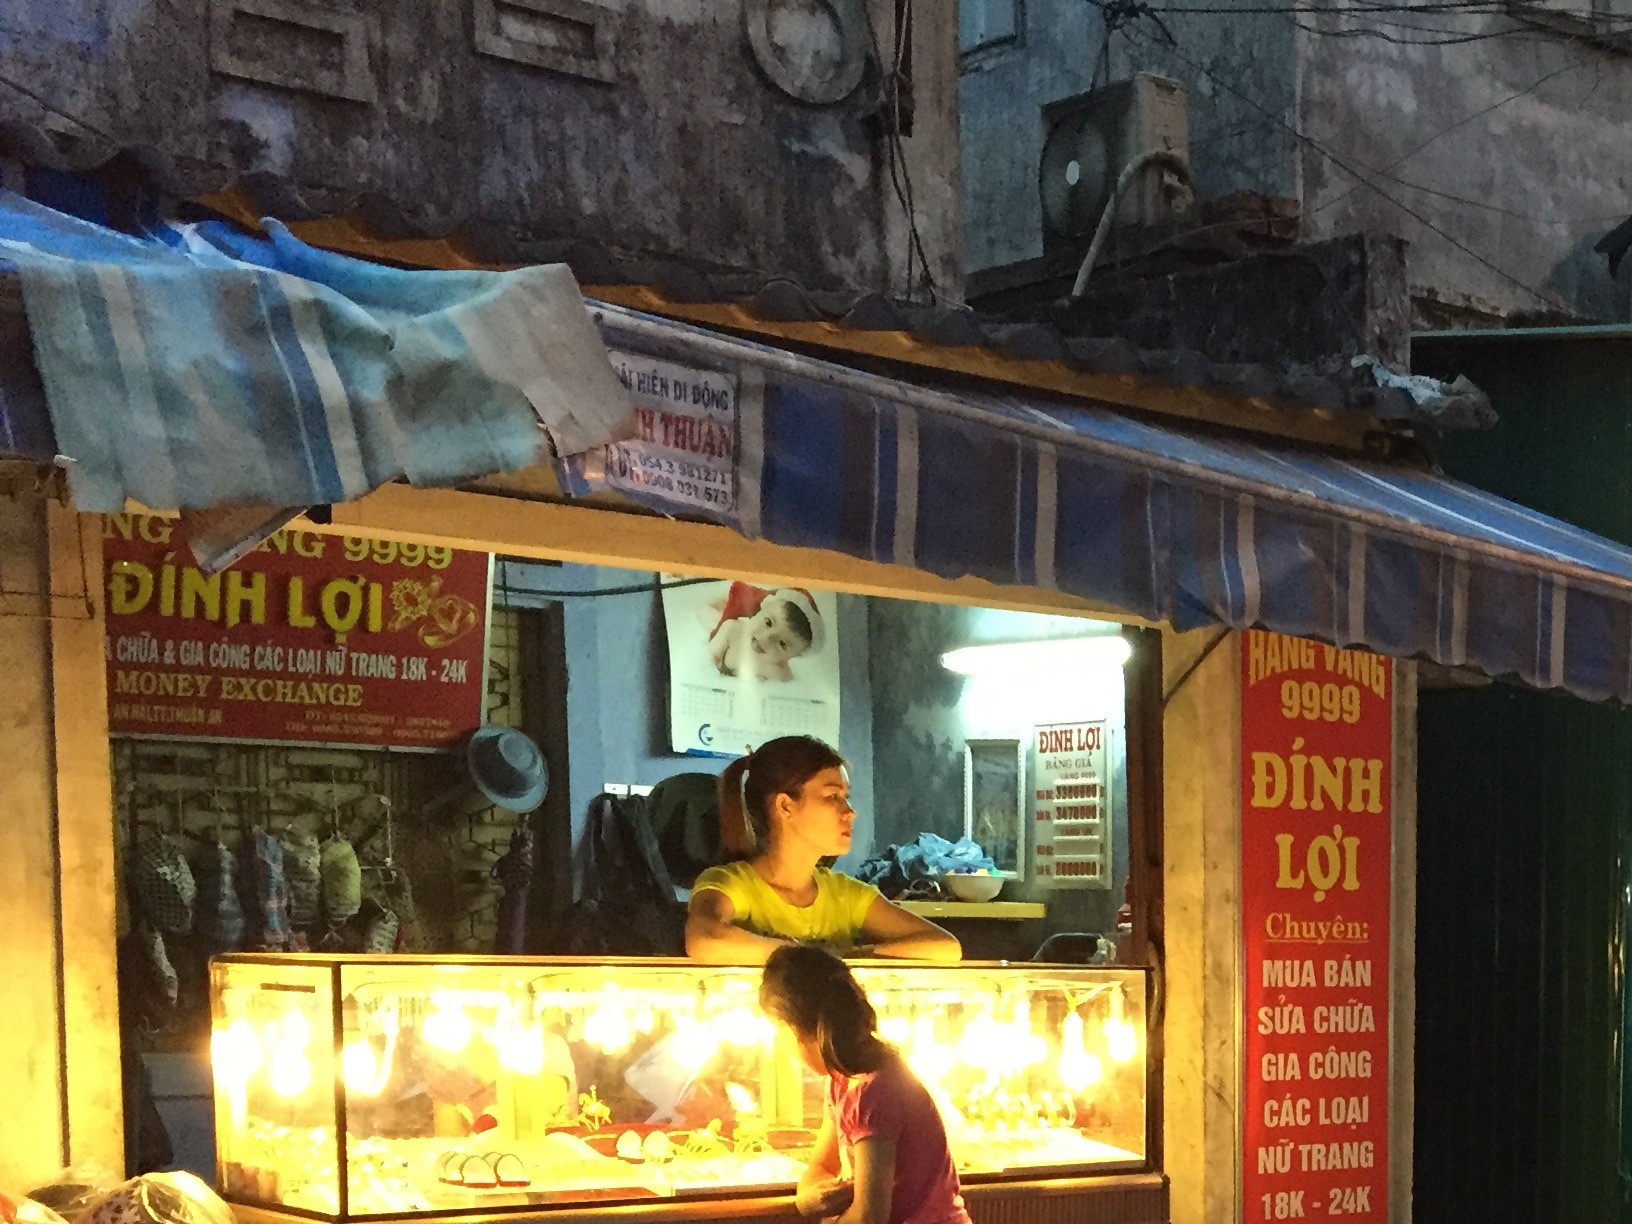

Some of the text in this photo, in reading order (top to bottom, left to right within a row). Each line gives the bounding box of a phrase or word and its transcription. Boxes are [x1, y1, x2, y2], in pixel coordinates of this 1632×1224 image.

[674, 379, 688, 399] DI
[692, 381, 728, 410] ĐỘNG
[660, 413, 732, 463] THUẬN
[107, 551, 384, 645] ĐÍNH LỢI
[117, 630, 159, 664] CHỮA
[164, 639, 176, 665] &
[180, 640, 204, 667] GIA
[209, 636, 251, 671] CÔNG
[254, 639, 284, 672] CÁC
[288, 648, 322, 679] LOẠI
[326, 645, 348, 677] NỮ
[350, 652, 397, 680] TRANG
[401, 656, 428, 681] 18K
[440, 658, 468, 684] 24K
[115, 670, 364, 707] MONEY EXCHANGE
[1281, 679, 1362, 724] 9999
[1251, 736, 1384, 814] ĐÍNH
[1275, 823, 1361, 903] LỢI
[1265, 913, 1369, 945] Chuyên:
[1262, 954, 1372, 988] MUA BÁN
[1257, 994, 1375, 1035] SỬA CHỮA
[1261, 1046, 1372, 1083] GIA CÔNG
[1263, 1092, 1369, 1130] CÁC LOẠI
[1257, 1138, 1374, 1175] NỮ TRANG
[1261, 1189, 1305, 1220] 18K
[1328, 1186, 1371, 1216] 24K
